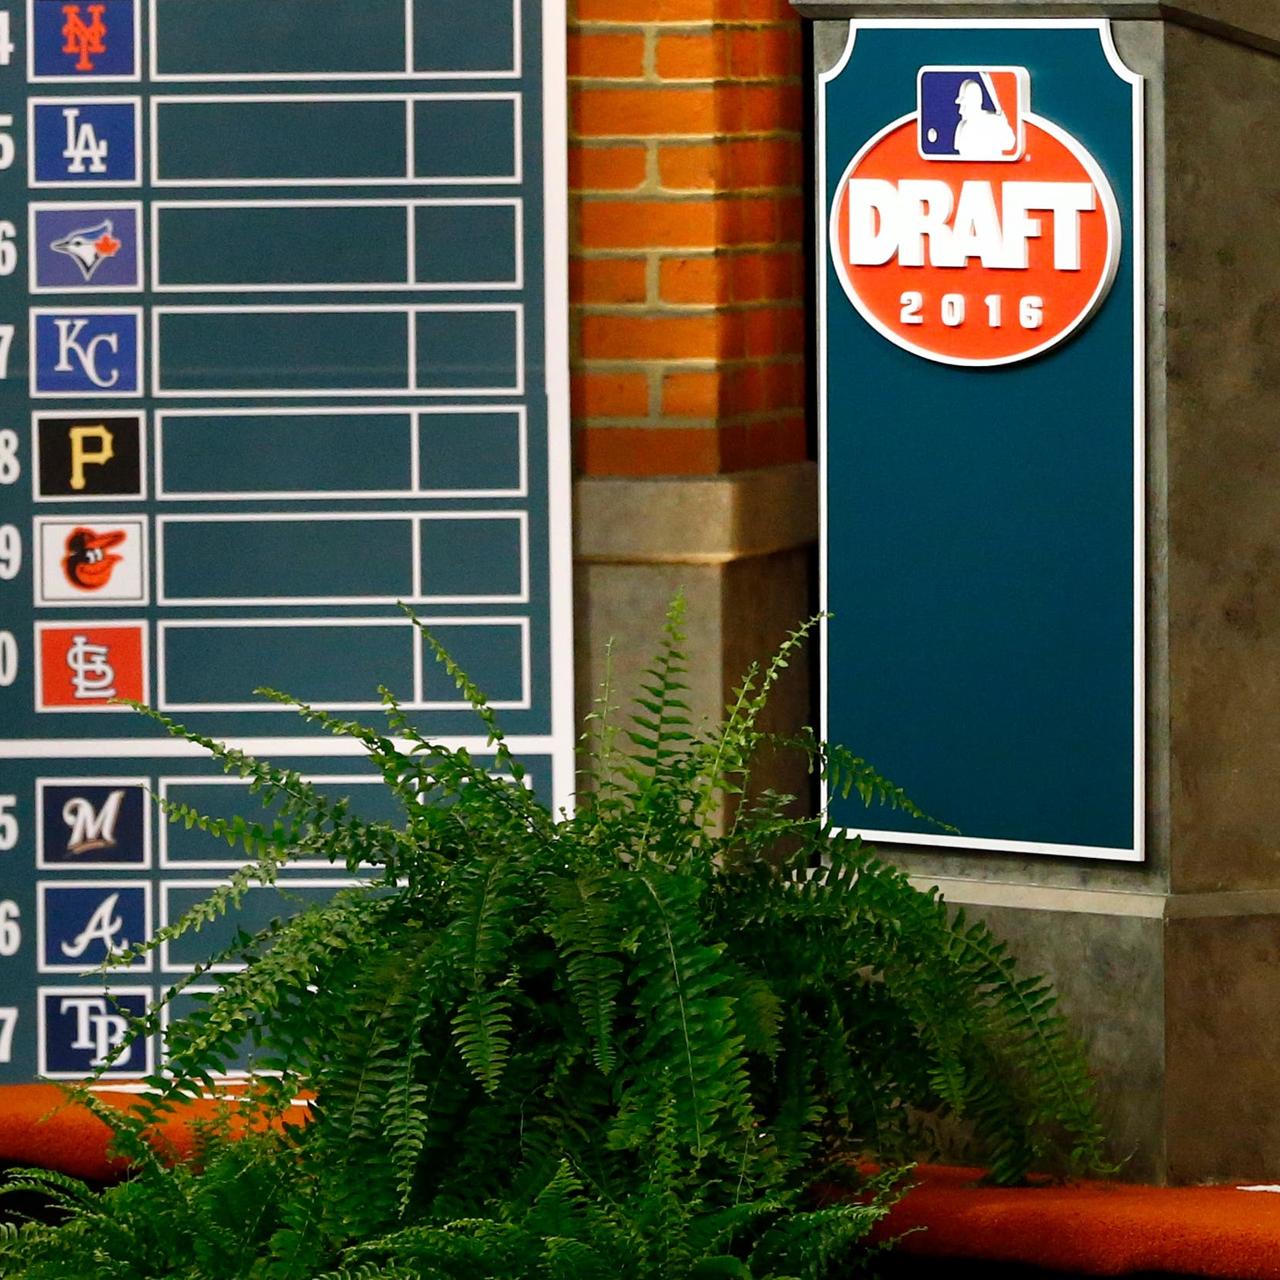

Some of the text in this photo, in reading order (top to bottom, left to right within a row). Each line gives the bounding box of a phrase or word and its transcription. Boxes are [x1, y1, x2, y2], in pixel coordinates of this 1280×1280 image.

[63, 108, 107, 173] LA
[848, 178, 1096, 271] DRAFT
[900, 291, 1043, 328] 2016
[53, 320, 119, 388] KC
[69, 425, 114, 489] P
[63, 790, 125, 854] M
[60, 892, 129, 958] A
[60, 998, 131, 1066] TB
